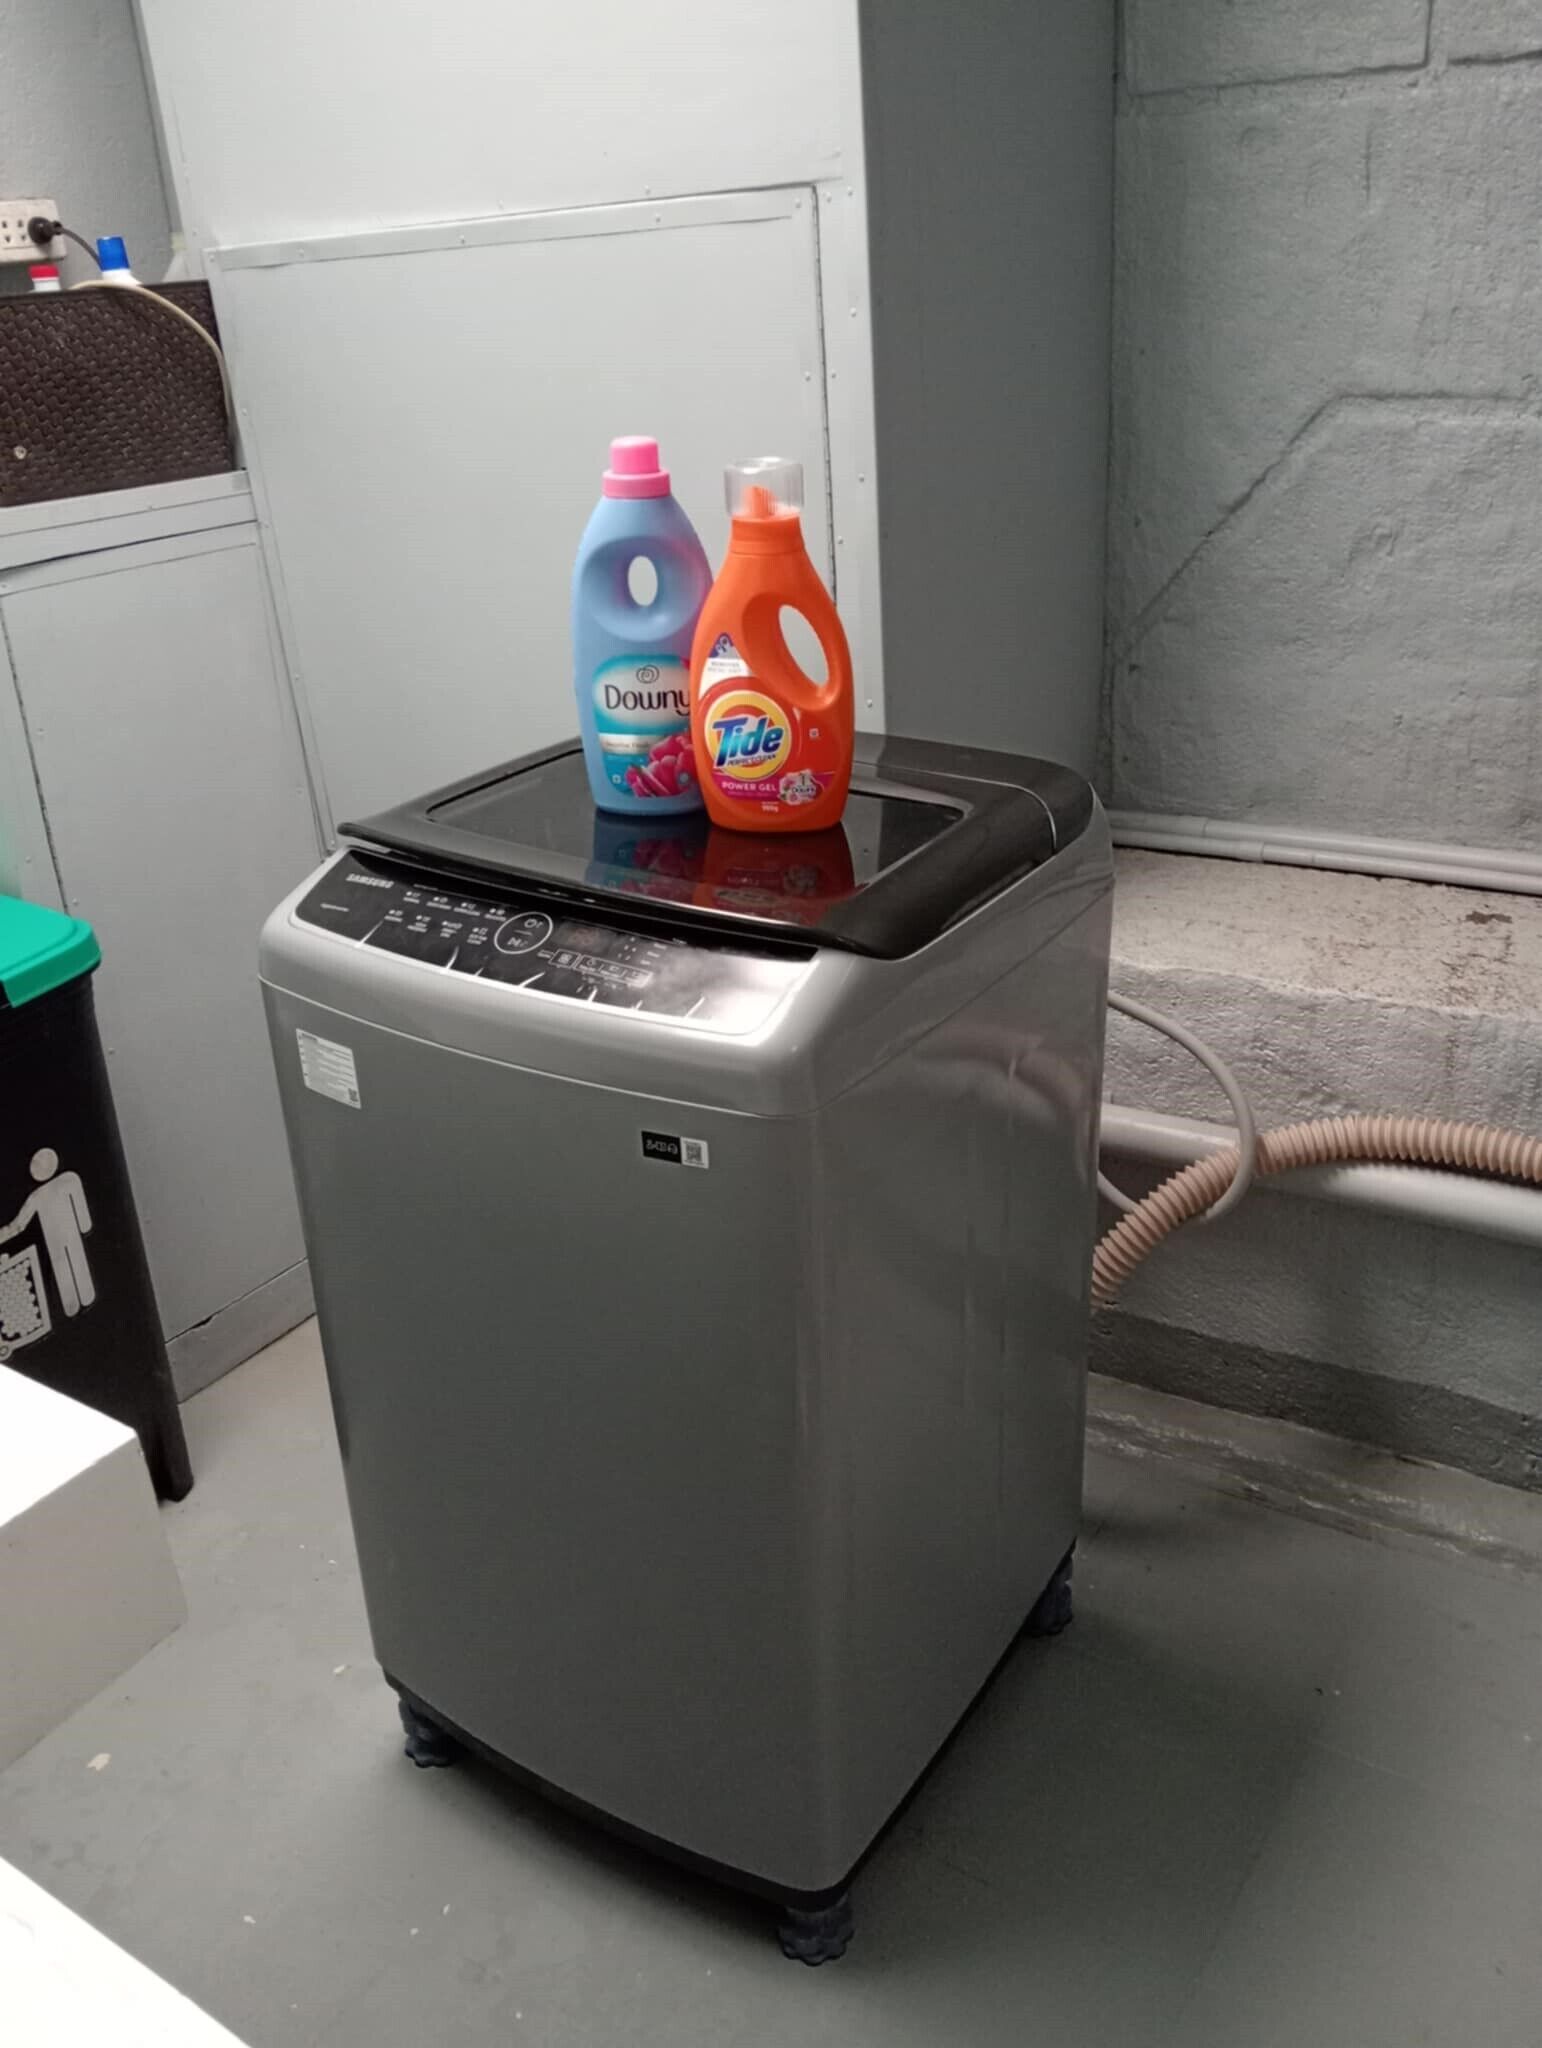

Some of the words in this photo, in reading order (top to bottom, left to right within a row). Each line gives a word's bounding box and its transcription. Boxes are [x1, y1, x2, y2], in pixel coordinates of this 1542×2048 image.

[604, 684, 691, 717] Downy
[712, 716, 785, 768] Tide
[721, 782, 757, 791] POWER
[758, 783, 777, 792] GEL
[345, 873, 395, 889] SAMSUNG
